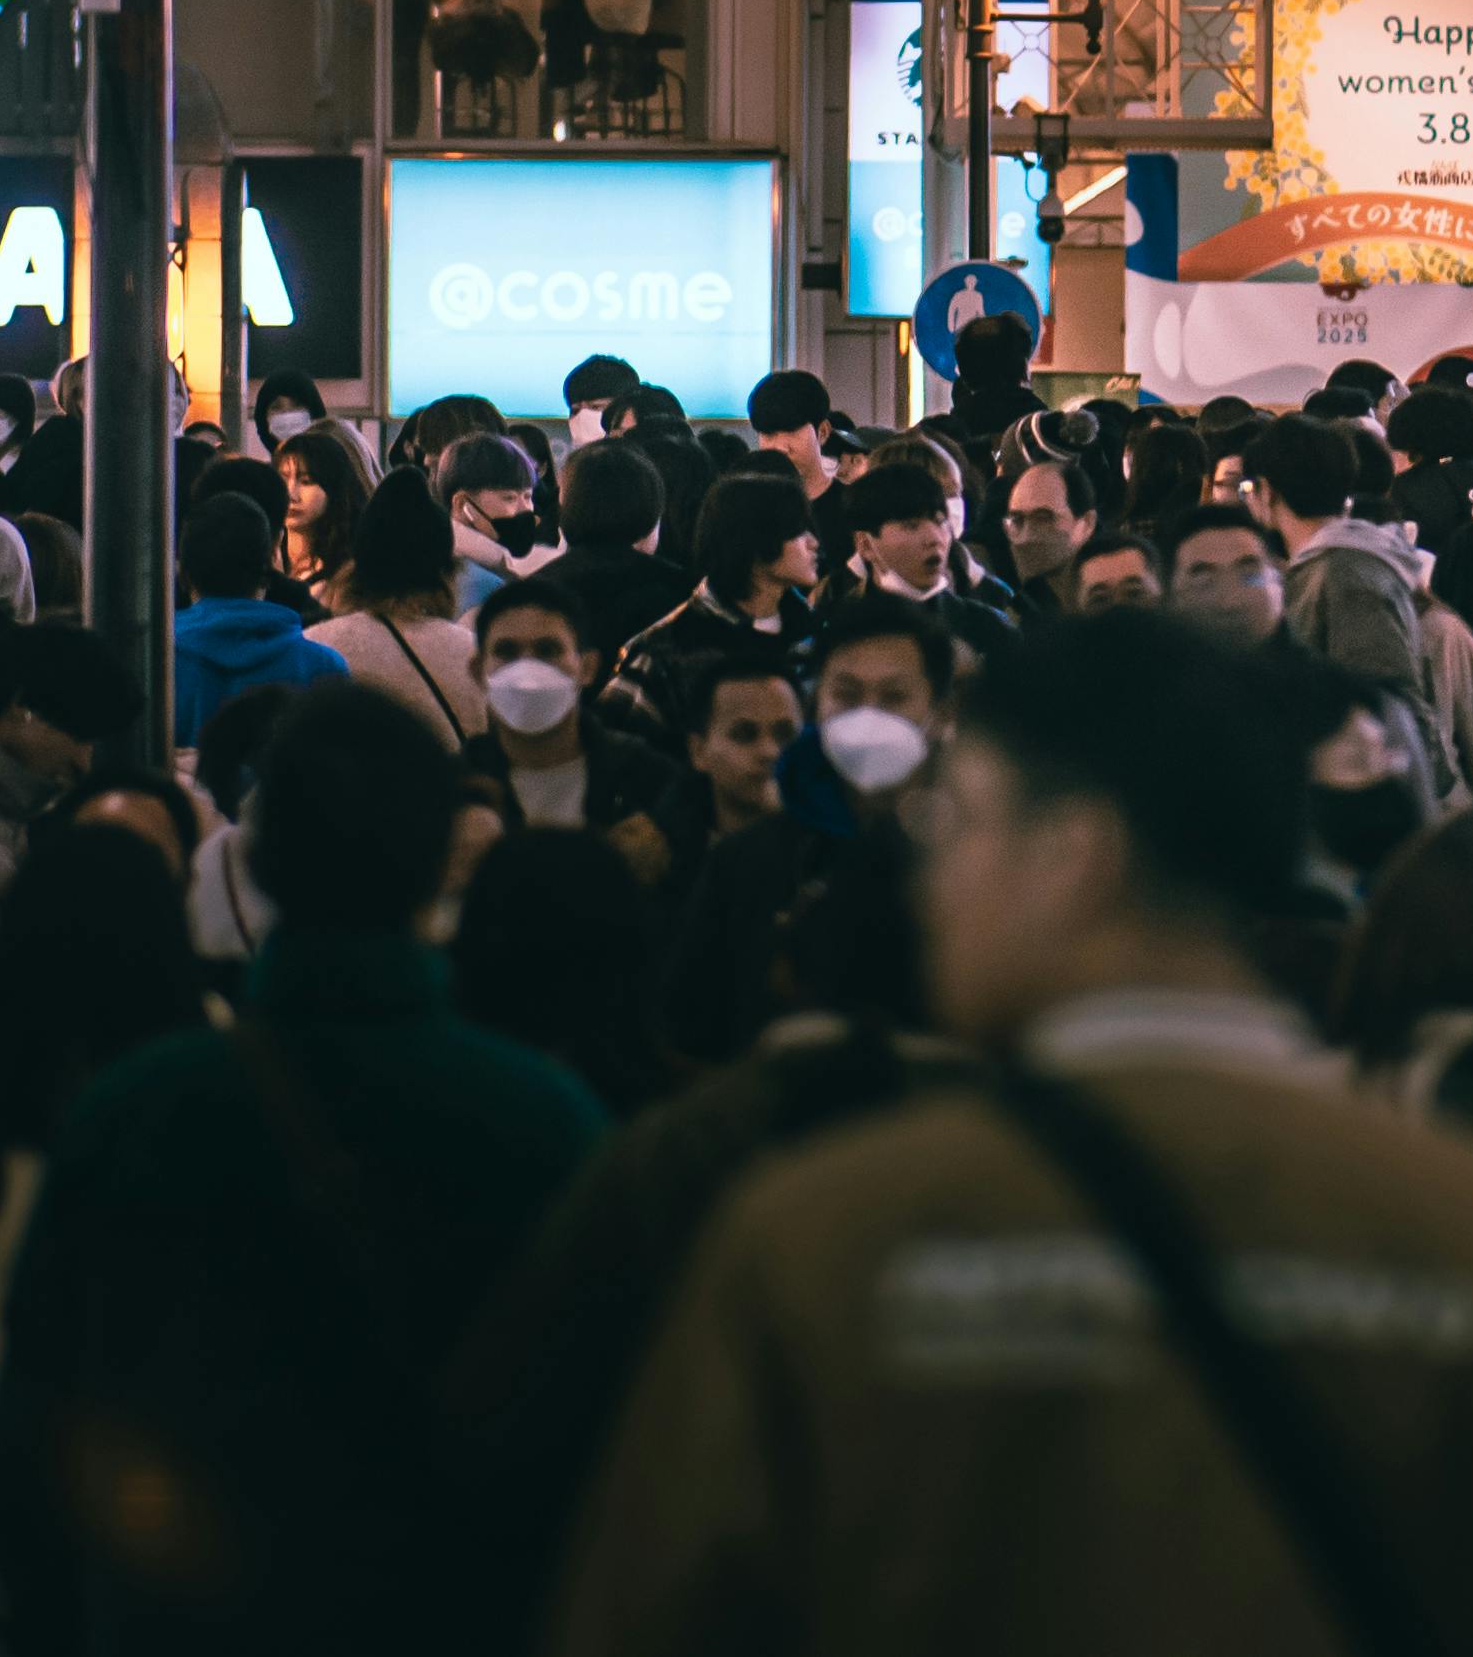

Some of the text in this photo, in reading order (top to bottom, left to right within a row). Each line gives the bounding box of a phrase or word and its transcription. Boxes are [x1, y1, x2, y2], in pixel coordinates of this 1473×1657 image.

[1416, 112, 1472, 146] 3.8
[428, 263, 733, 328] @cosme
[1316, 312, 1368, 327] EXPO
[1317, 328, 1368, 343] 2025
